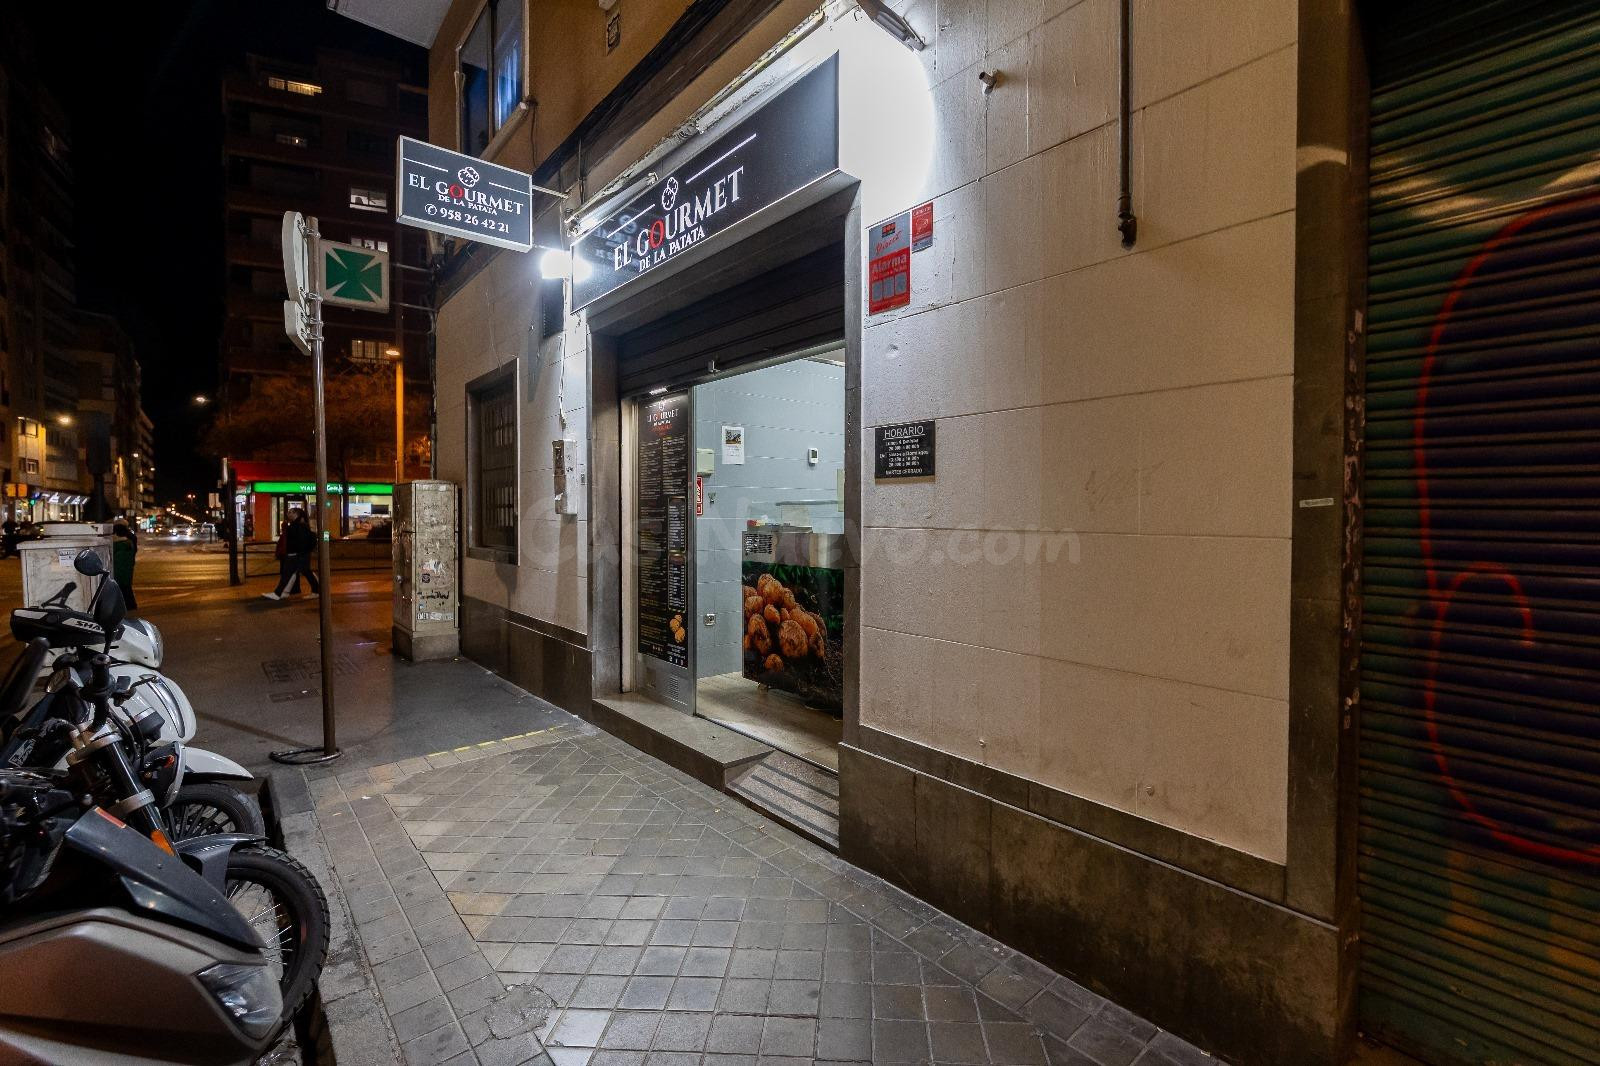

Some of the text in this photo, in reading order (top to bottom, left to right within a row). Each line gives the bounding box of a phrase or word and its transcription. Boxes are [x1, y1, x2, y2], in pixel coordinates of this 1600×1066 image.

[408, 173, 524, 215] EL GOURMET
[438, 194, 498, 215] DE LA PATATA
[440, 208, 510, 233] 958 26 42 21
[613, 165, 744, 271] EL GOURMET
[638, 225, 705, 272] DE LA PATATA
[884, 425, 924, 438] HORARIO
[76, 620, 104, 632] SHA
